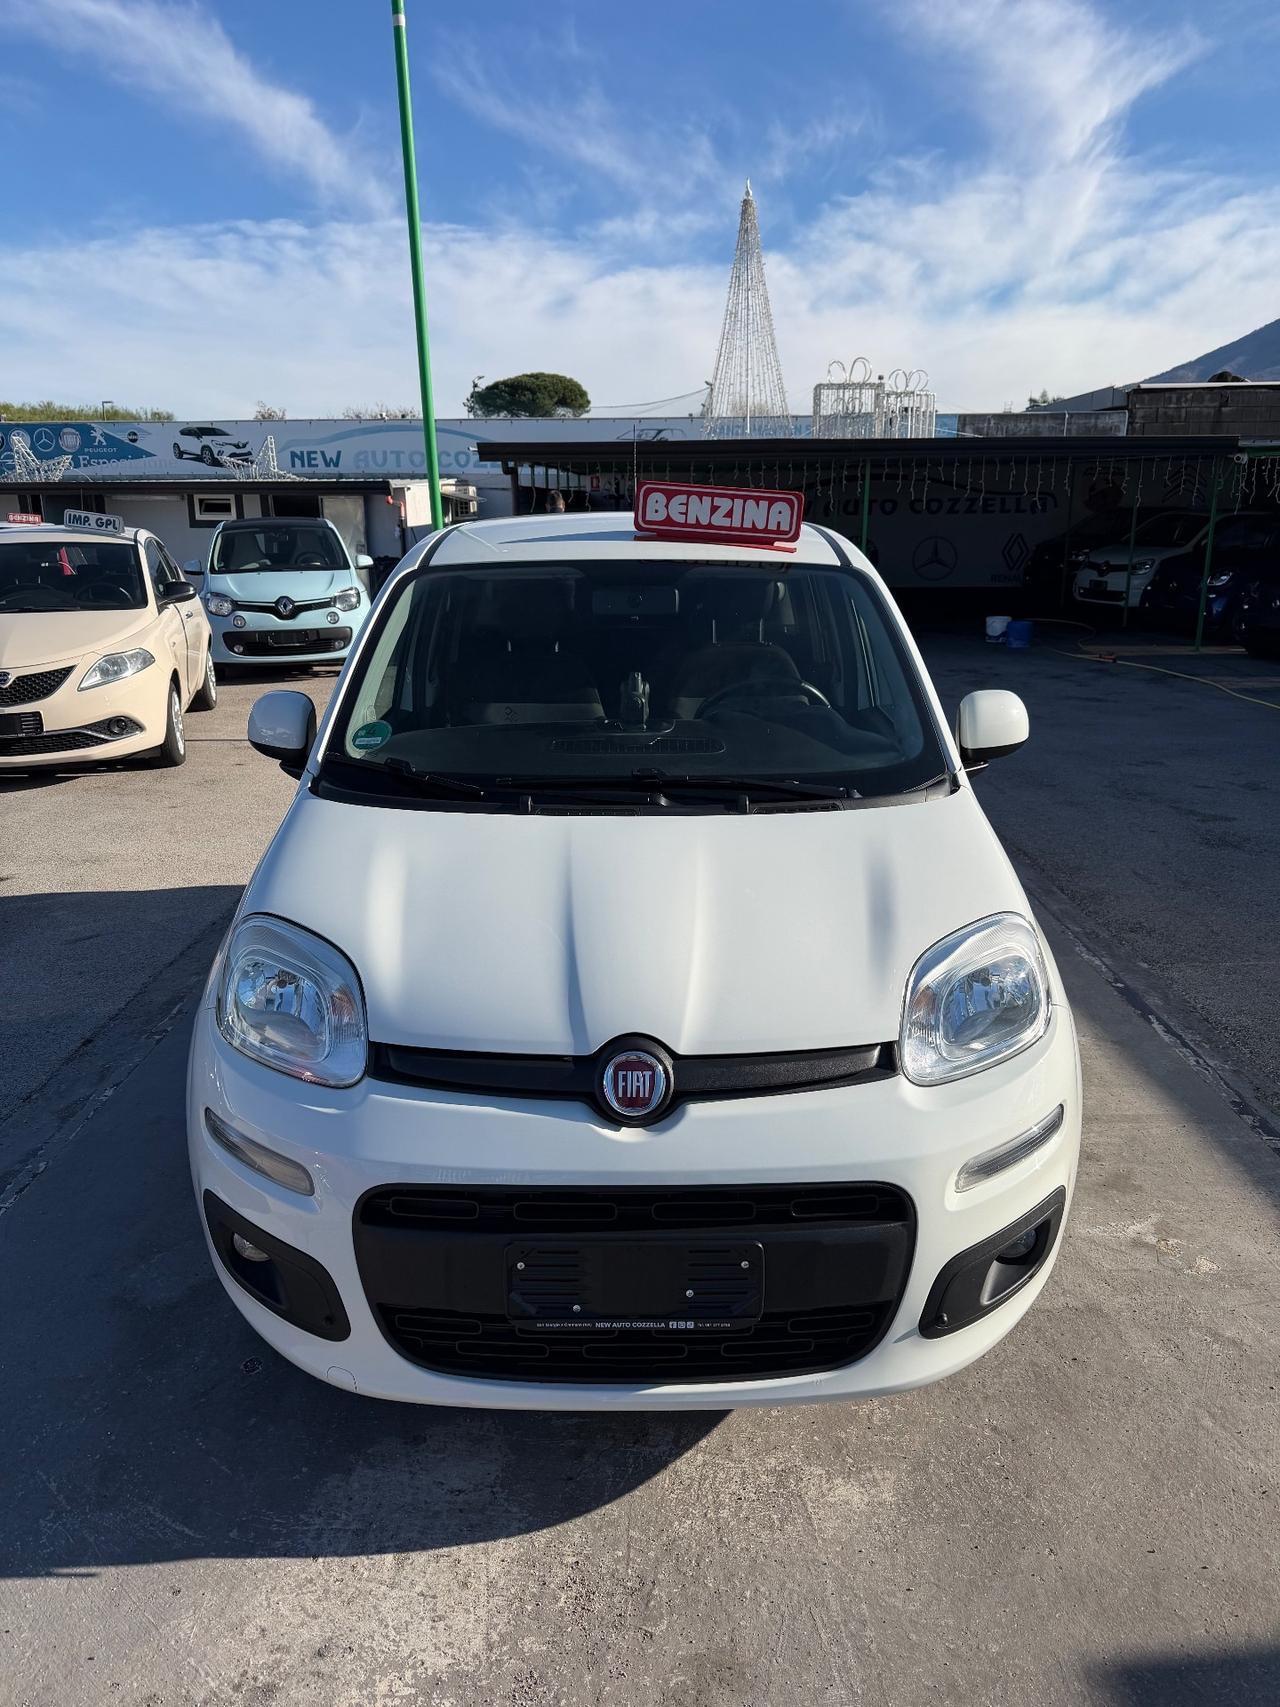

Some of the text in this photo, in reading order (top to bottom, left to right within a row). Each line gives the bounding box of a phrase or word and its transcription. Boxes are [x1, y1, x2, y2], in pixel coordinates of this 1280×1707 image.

[290, 450, 342, 469] NEW
[353, 450, 425, 469] AUTO
[645, 491, 793, 532] BENZINA
[909, 496, 1049, 516] COZZELLA
[67, 512, 118, 531] IMP. GPL
[617, 1070, 653, 1098] FIAT
